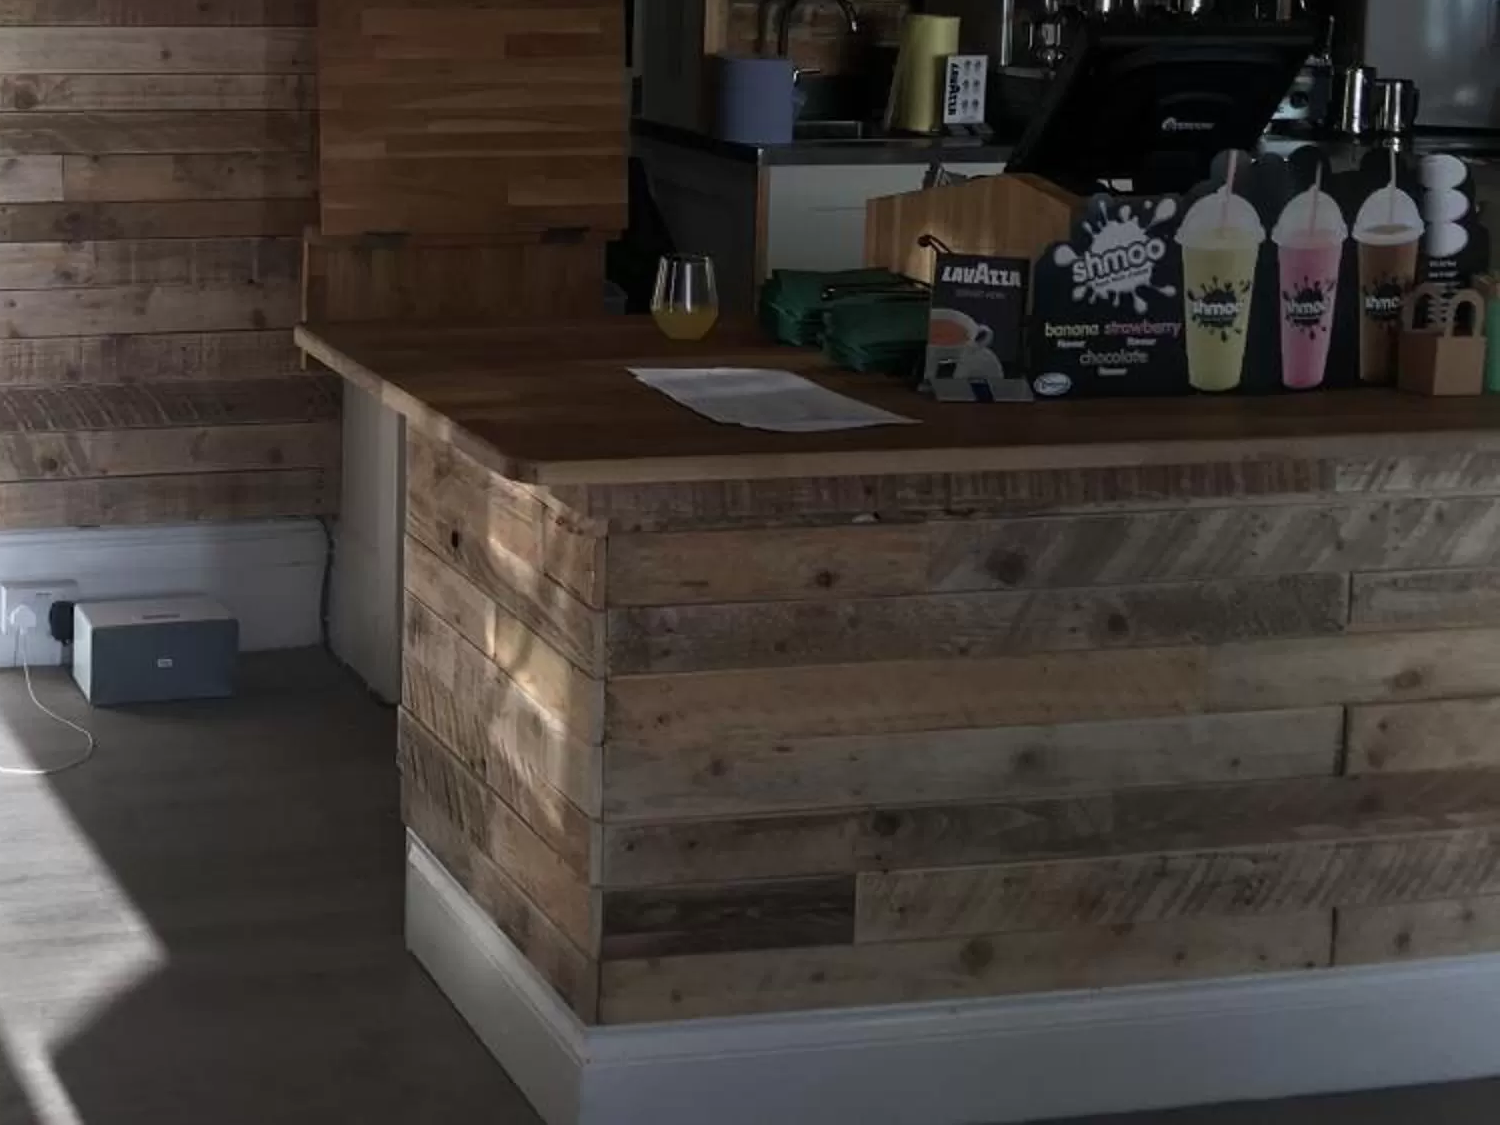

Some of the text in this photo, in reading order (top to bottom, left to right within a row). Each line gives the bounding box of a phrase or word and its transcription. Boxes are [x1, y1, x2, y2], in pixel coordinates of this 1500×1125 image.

[1072, 237, 1166, 284] shmoo
[941, 262, 1022, 287] LAVAZZA
[1045, 320, 1182, 338] banana strawberry
[1079, 349, 1149, 365] chocolate
